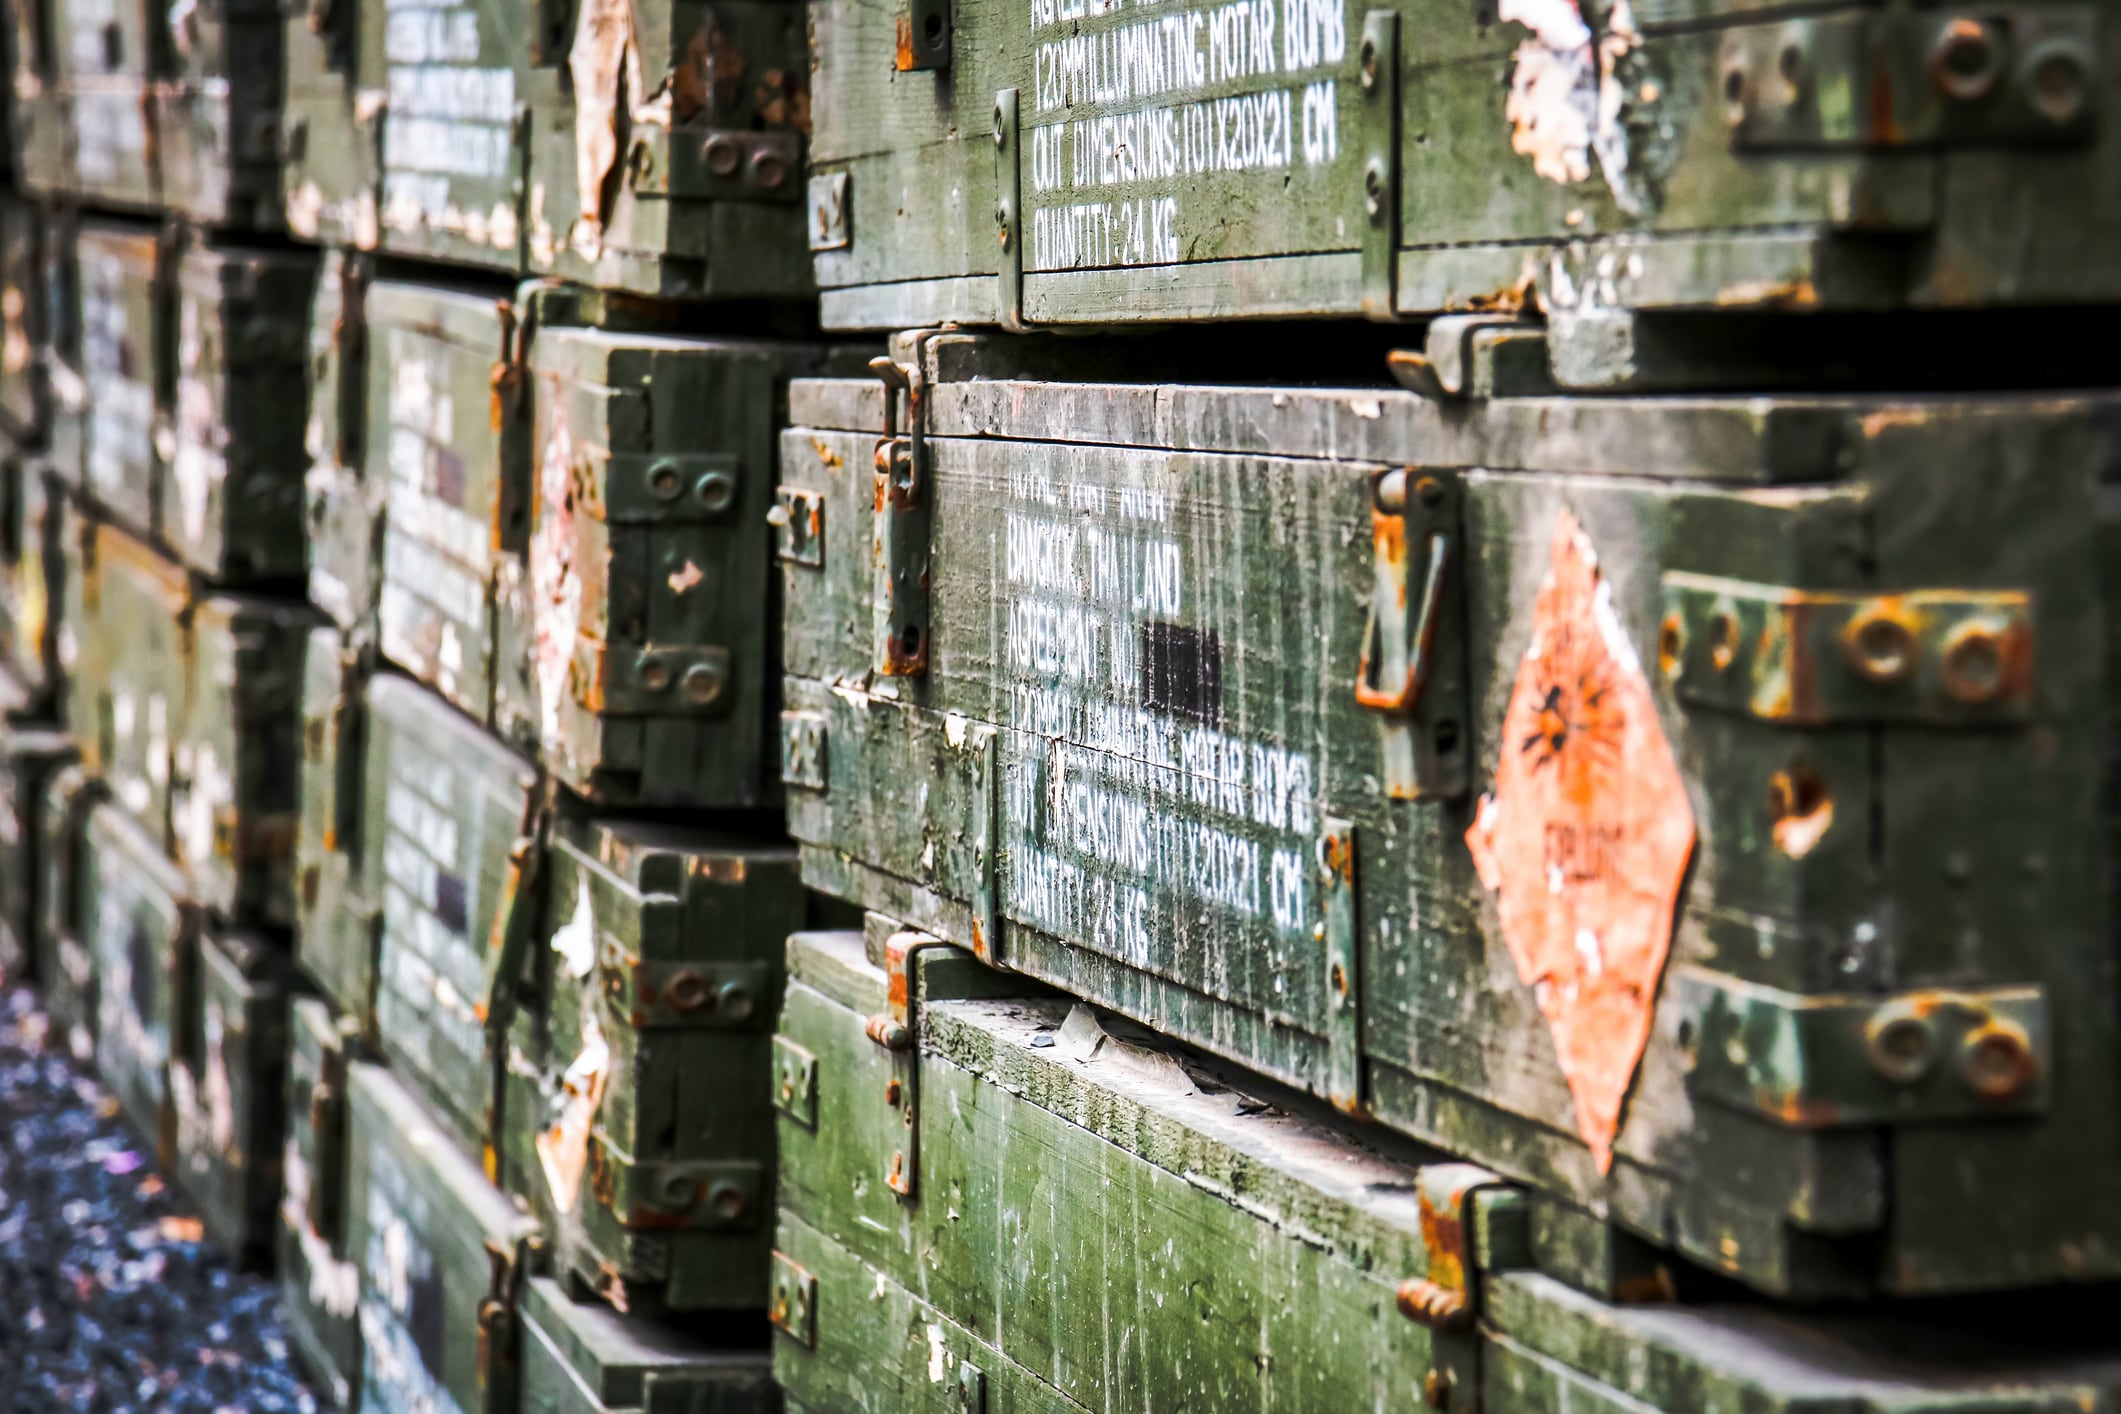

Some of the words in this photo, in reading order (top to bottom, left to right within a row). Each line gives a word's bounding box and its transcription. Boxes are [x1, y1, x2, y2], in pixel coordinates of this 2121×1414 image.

[1209, 0, 1276, 82] MOTAR
[1284, 0, 1345, 73] BOMB
[1033, 122, 1065, 191] OUT
[1302, 79, 1337, 165] CM
[1152, 196, 1179, 265] KG
[1087, 525, 1181, 615] THAILAND
[1181, 729, 1246, 818] MOTAR
[1252, 741, 1312, 835] BOMB
[1124, 886, 1148, 969] KG
[1271, 848, 1304, 931] CM
